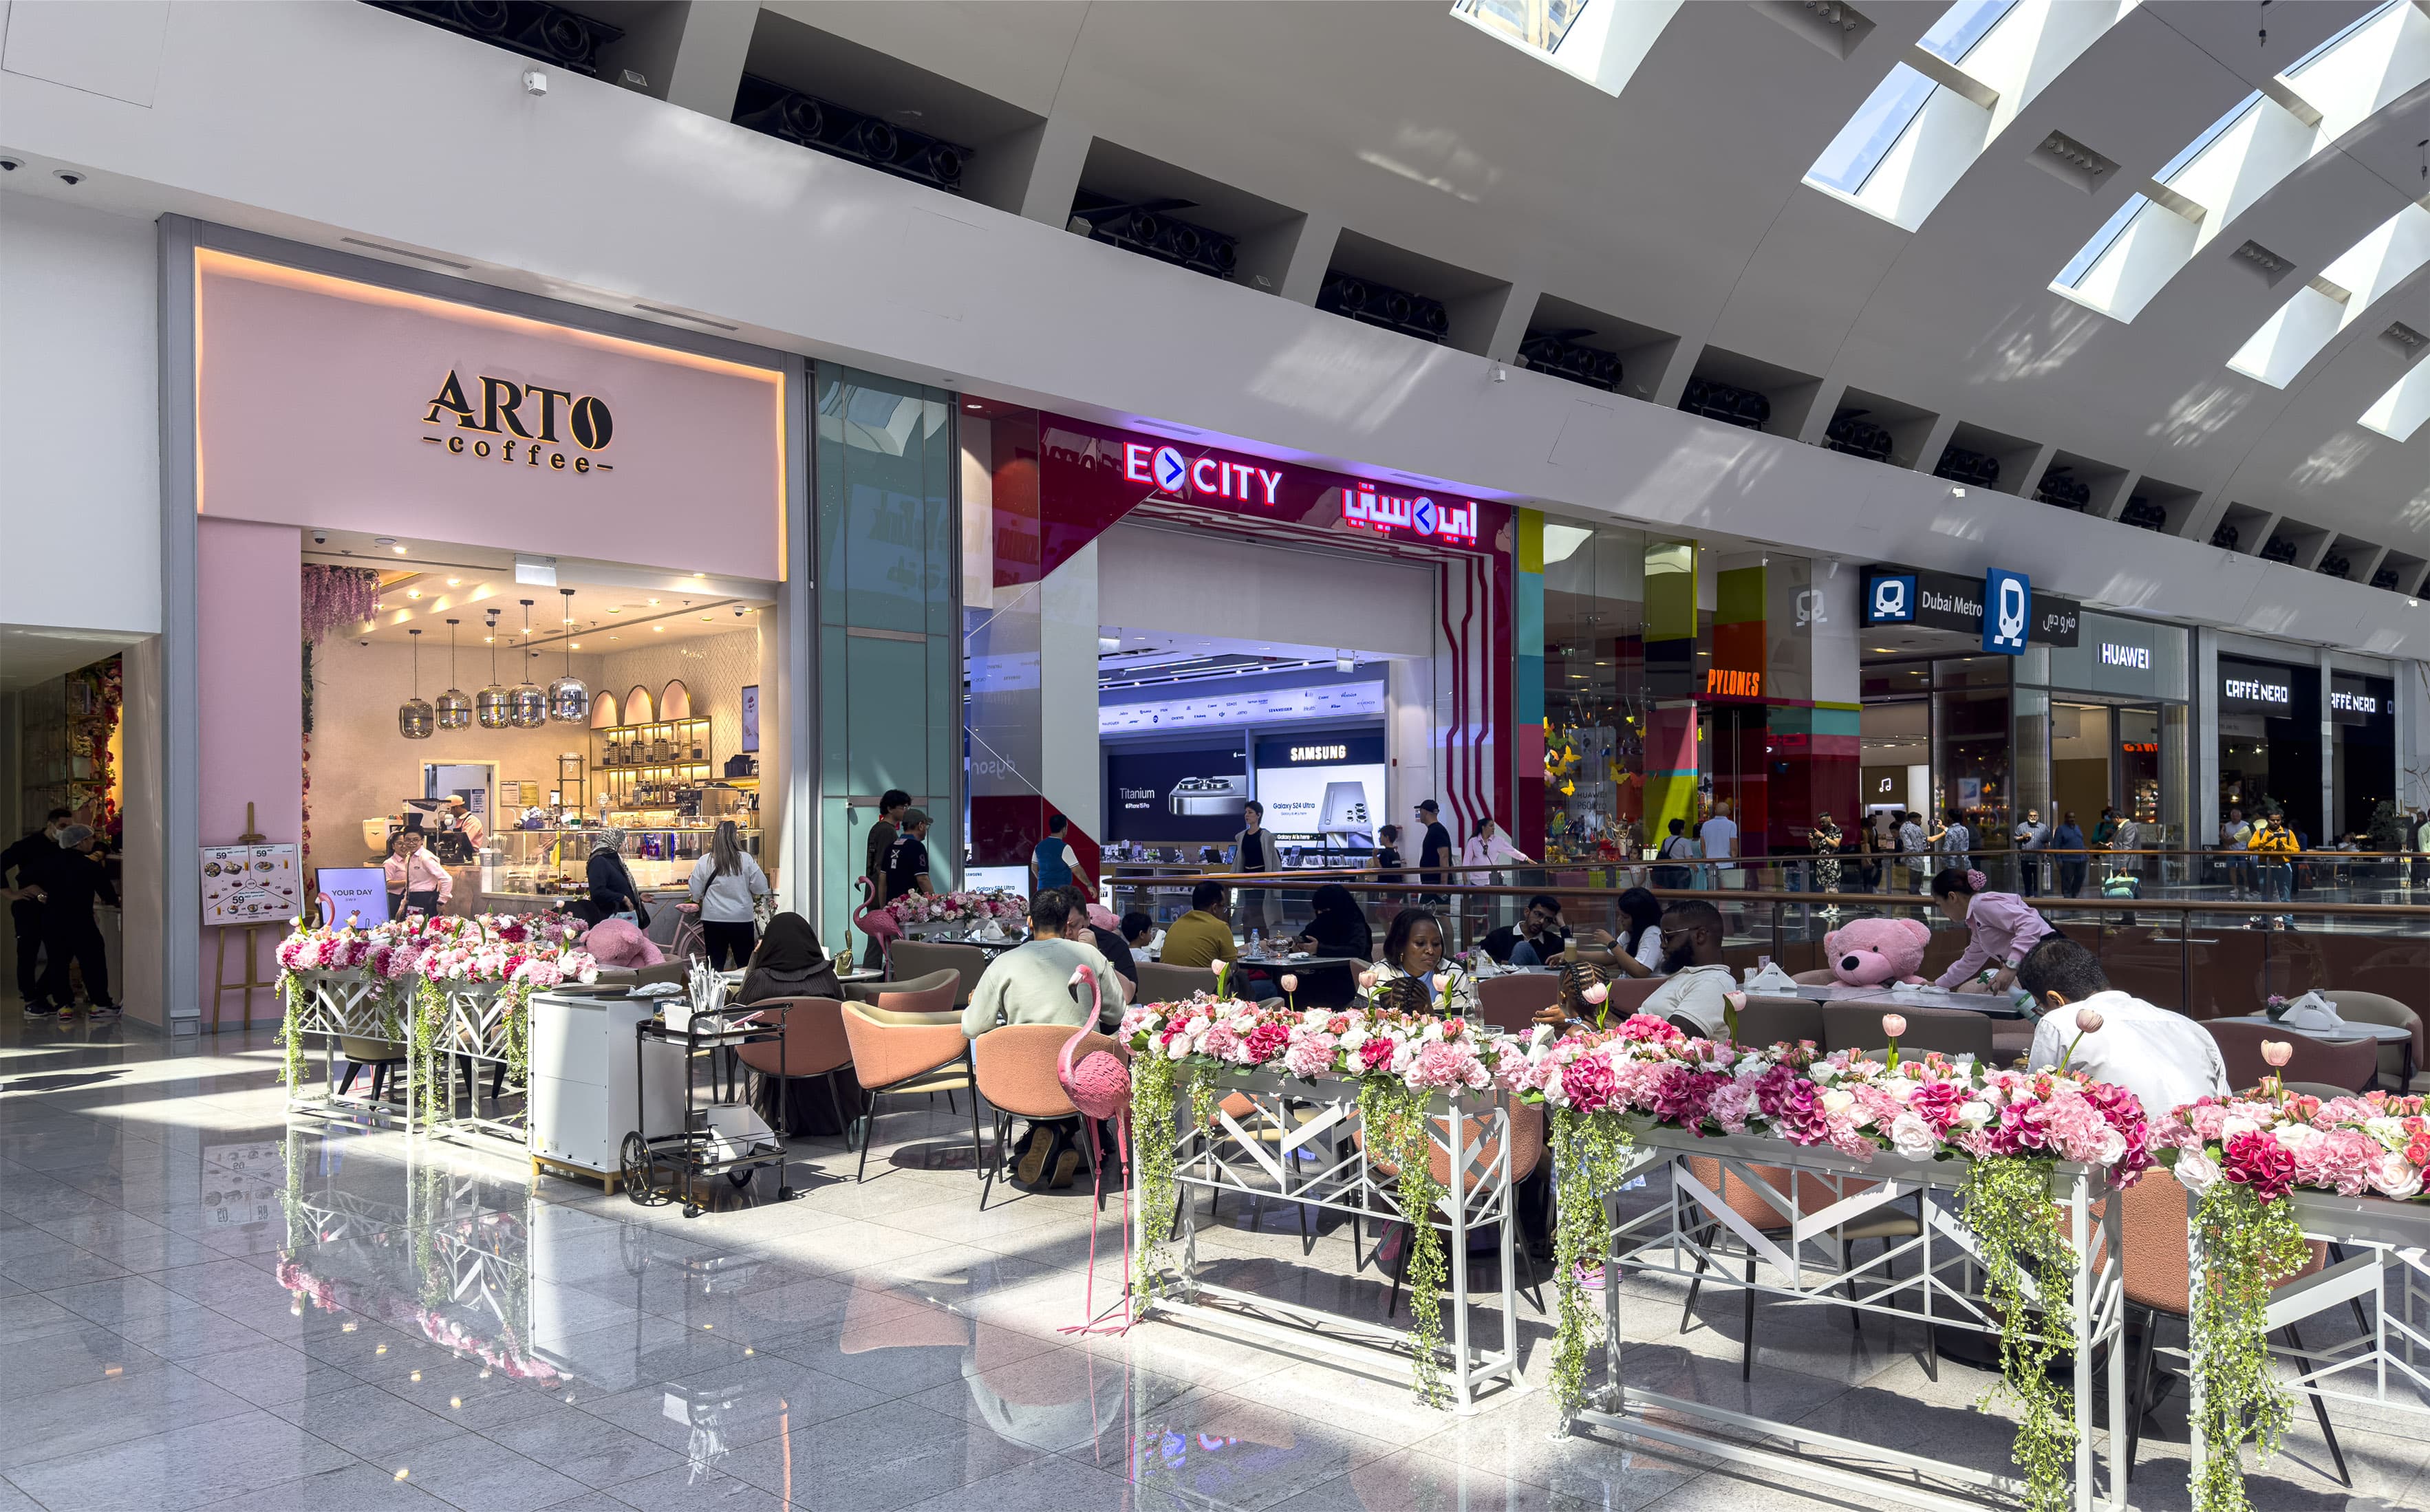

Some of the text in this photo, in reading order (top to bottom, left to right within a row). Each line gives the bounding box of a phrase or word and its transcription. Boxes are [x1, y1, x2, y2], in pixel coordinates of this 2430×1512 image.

[422, 369, 614, 451] ARTO
[447, 436, 590, 473] coffee
[1922, 591, 1983, 618] Dubai Metro
[2043, 612, 2076, 634] مترو دبي
[2101, 643, 2150, 670] HUAWEI
[1707, 669, 1760, 697] PYLONES
[2226, 679, 2288, 703] CAFFÈ NERO
[2353, 695, 2376, 713] NERO
[1290, 745, 1346, 762] SAMSUNG
[1119, 787, 1155, 799] Titanium
[1273, 802, 1291, 811] Galaxy
[232, 896, 244, 904] 59
